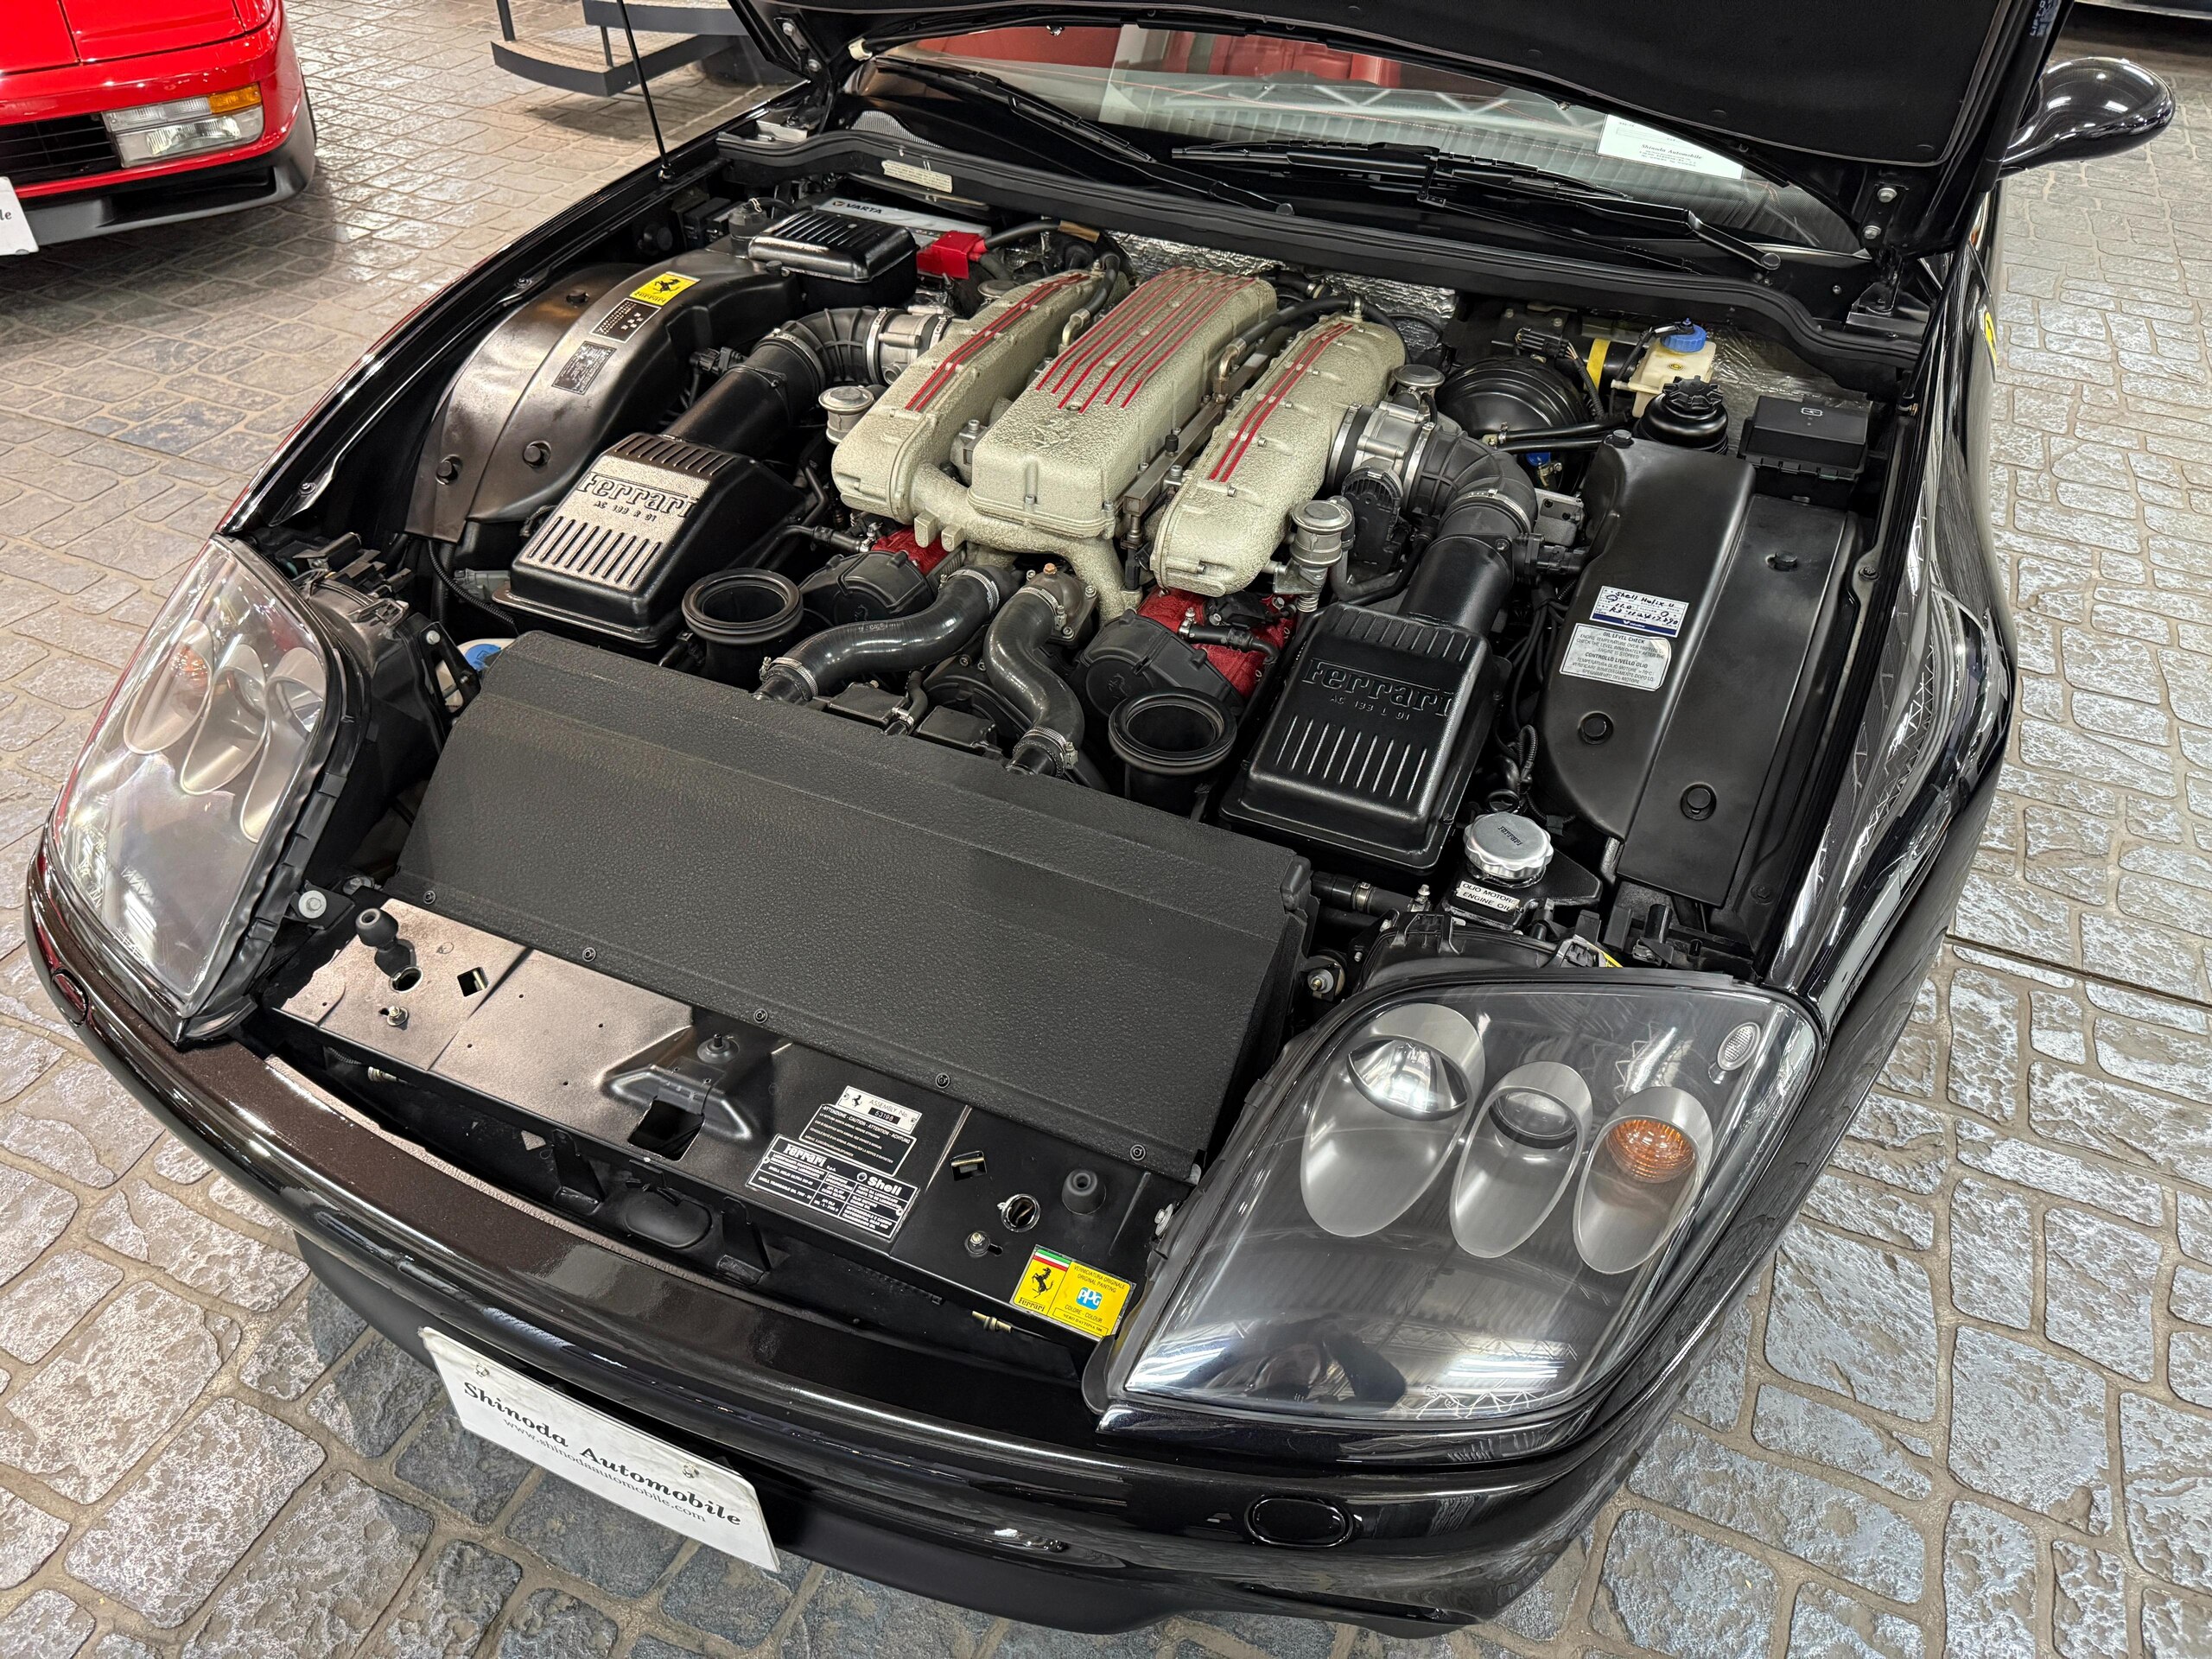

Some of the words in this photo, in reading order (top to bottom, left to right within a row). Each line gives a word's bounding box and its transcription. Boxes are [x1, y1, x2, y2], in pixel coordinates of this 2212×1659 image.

[847, 203, 882, 213] VARTA
[635, 291, 666, 302] Ferrari
[577, 472, 699, 518] Ferrari
[1615, 591, 1637, 600] Shell
[1596, 637, 1626, 646] TEMPERATURE
[1613, 645, 1642, 654] IMMEDIATELY
[1576, 658, 1607, 667] TEMPERATURA
[1585, 652, 1615, 662] CONTROLLO
[1596, 666, 1634, 677] IMMEDIATAMENTE
[1302, 658, 1455, 716] Ferrari
[1355, 701, 1374, 711] 133
[1497, 826, 1522, 846] Ferrari
[1463, 883, 1481, 892] OLIO
[1484, 890, 1518, 904] MOTORE
[1463, 892, 1495, 905] ENGINE
[870, 1099, 898, 1112] ASSEMBLY
[822, 1106, 848, 1118] ATTENZIONE
[848, 1116, 867, 1126] CAUTION
[867, 1123, 890, 1135] ATTENTION
[890, 1133, 911, 1144] ACHTUNG
[783, 1143, 828, 1167] Ferrari
[866, 1176, 903, 1196] Shell
[1074, 1266, 1103, 1282] VERNICIATURA
[1103, 1276, 1125, 1289] ORIGINALE
[1077, 1274, 1096, 1286] ORIGINAL
[1097, 1281, 1116, 1293] PAINTING
[1019, 1297, 1046, 1312] Ferrari
[1077, 1288, 1102, 1306] PPG
[1065, 1305, 1082, 1314] COLORE
[1085, 1310, 1103, 1323] COLOUR
[464, 1382, 569, 1446] Shinoda
[580, 1447, 741, 1525] Automobile
[504, 1419, 706, 1522] www.shinodaautomobile.com
